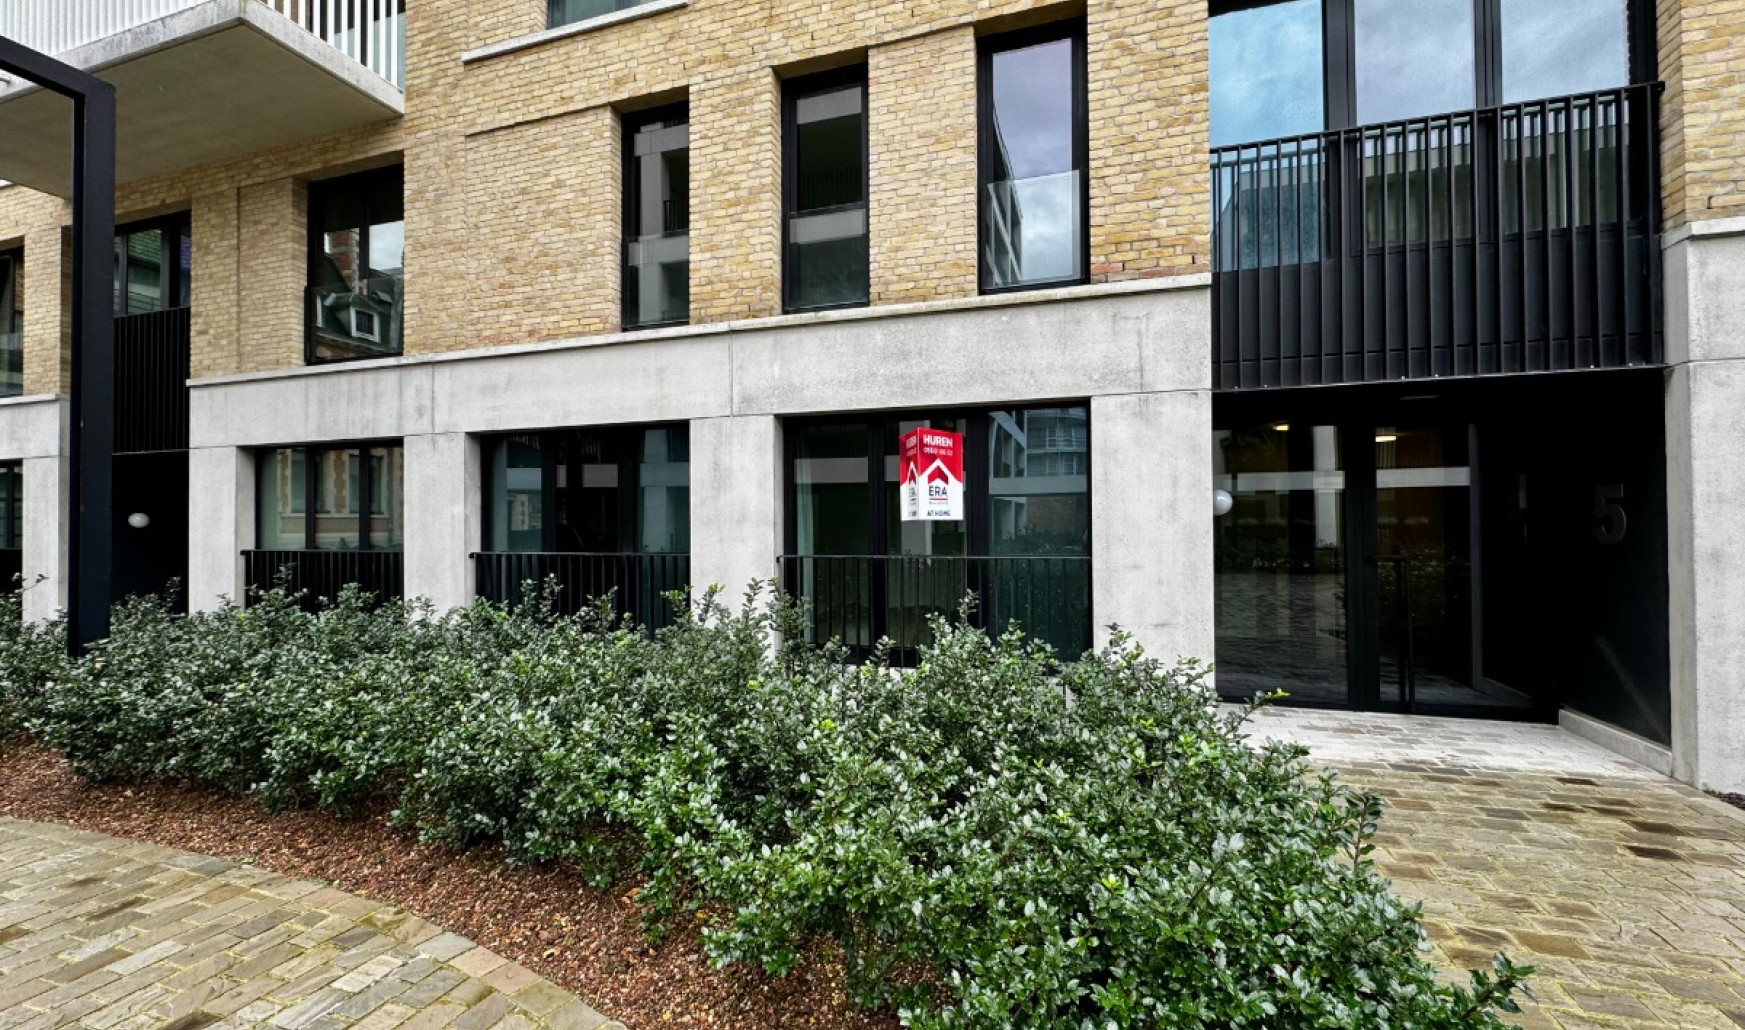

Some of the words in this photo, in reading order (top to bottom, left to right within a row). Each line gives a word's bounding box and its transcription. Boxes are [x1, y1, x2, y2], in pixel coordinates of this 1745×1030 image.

[923, 434, 953, 447] HUREN
[928, 485, 948, 497] ERA
[1592, 484, 1627, 545] 5
